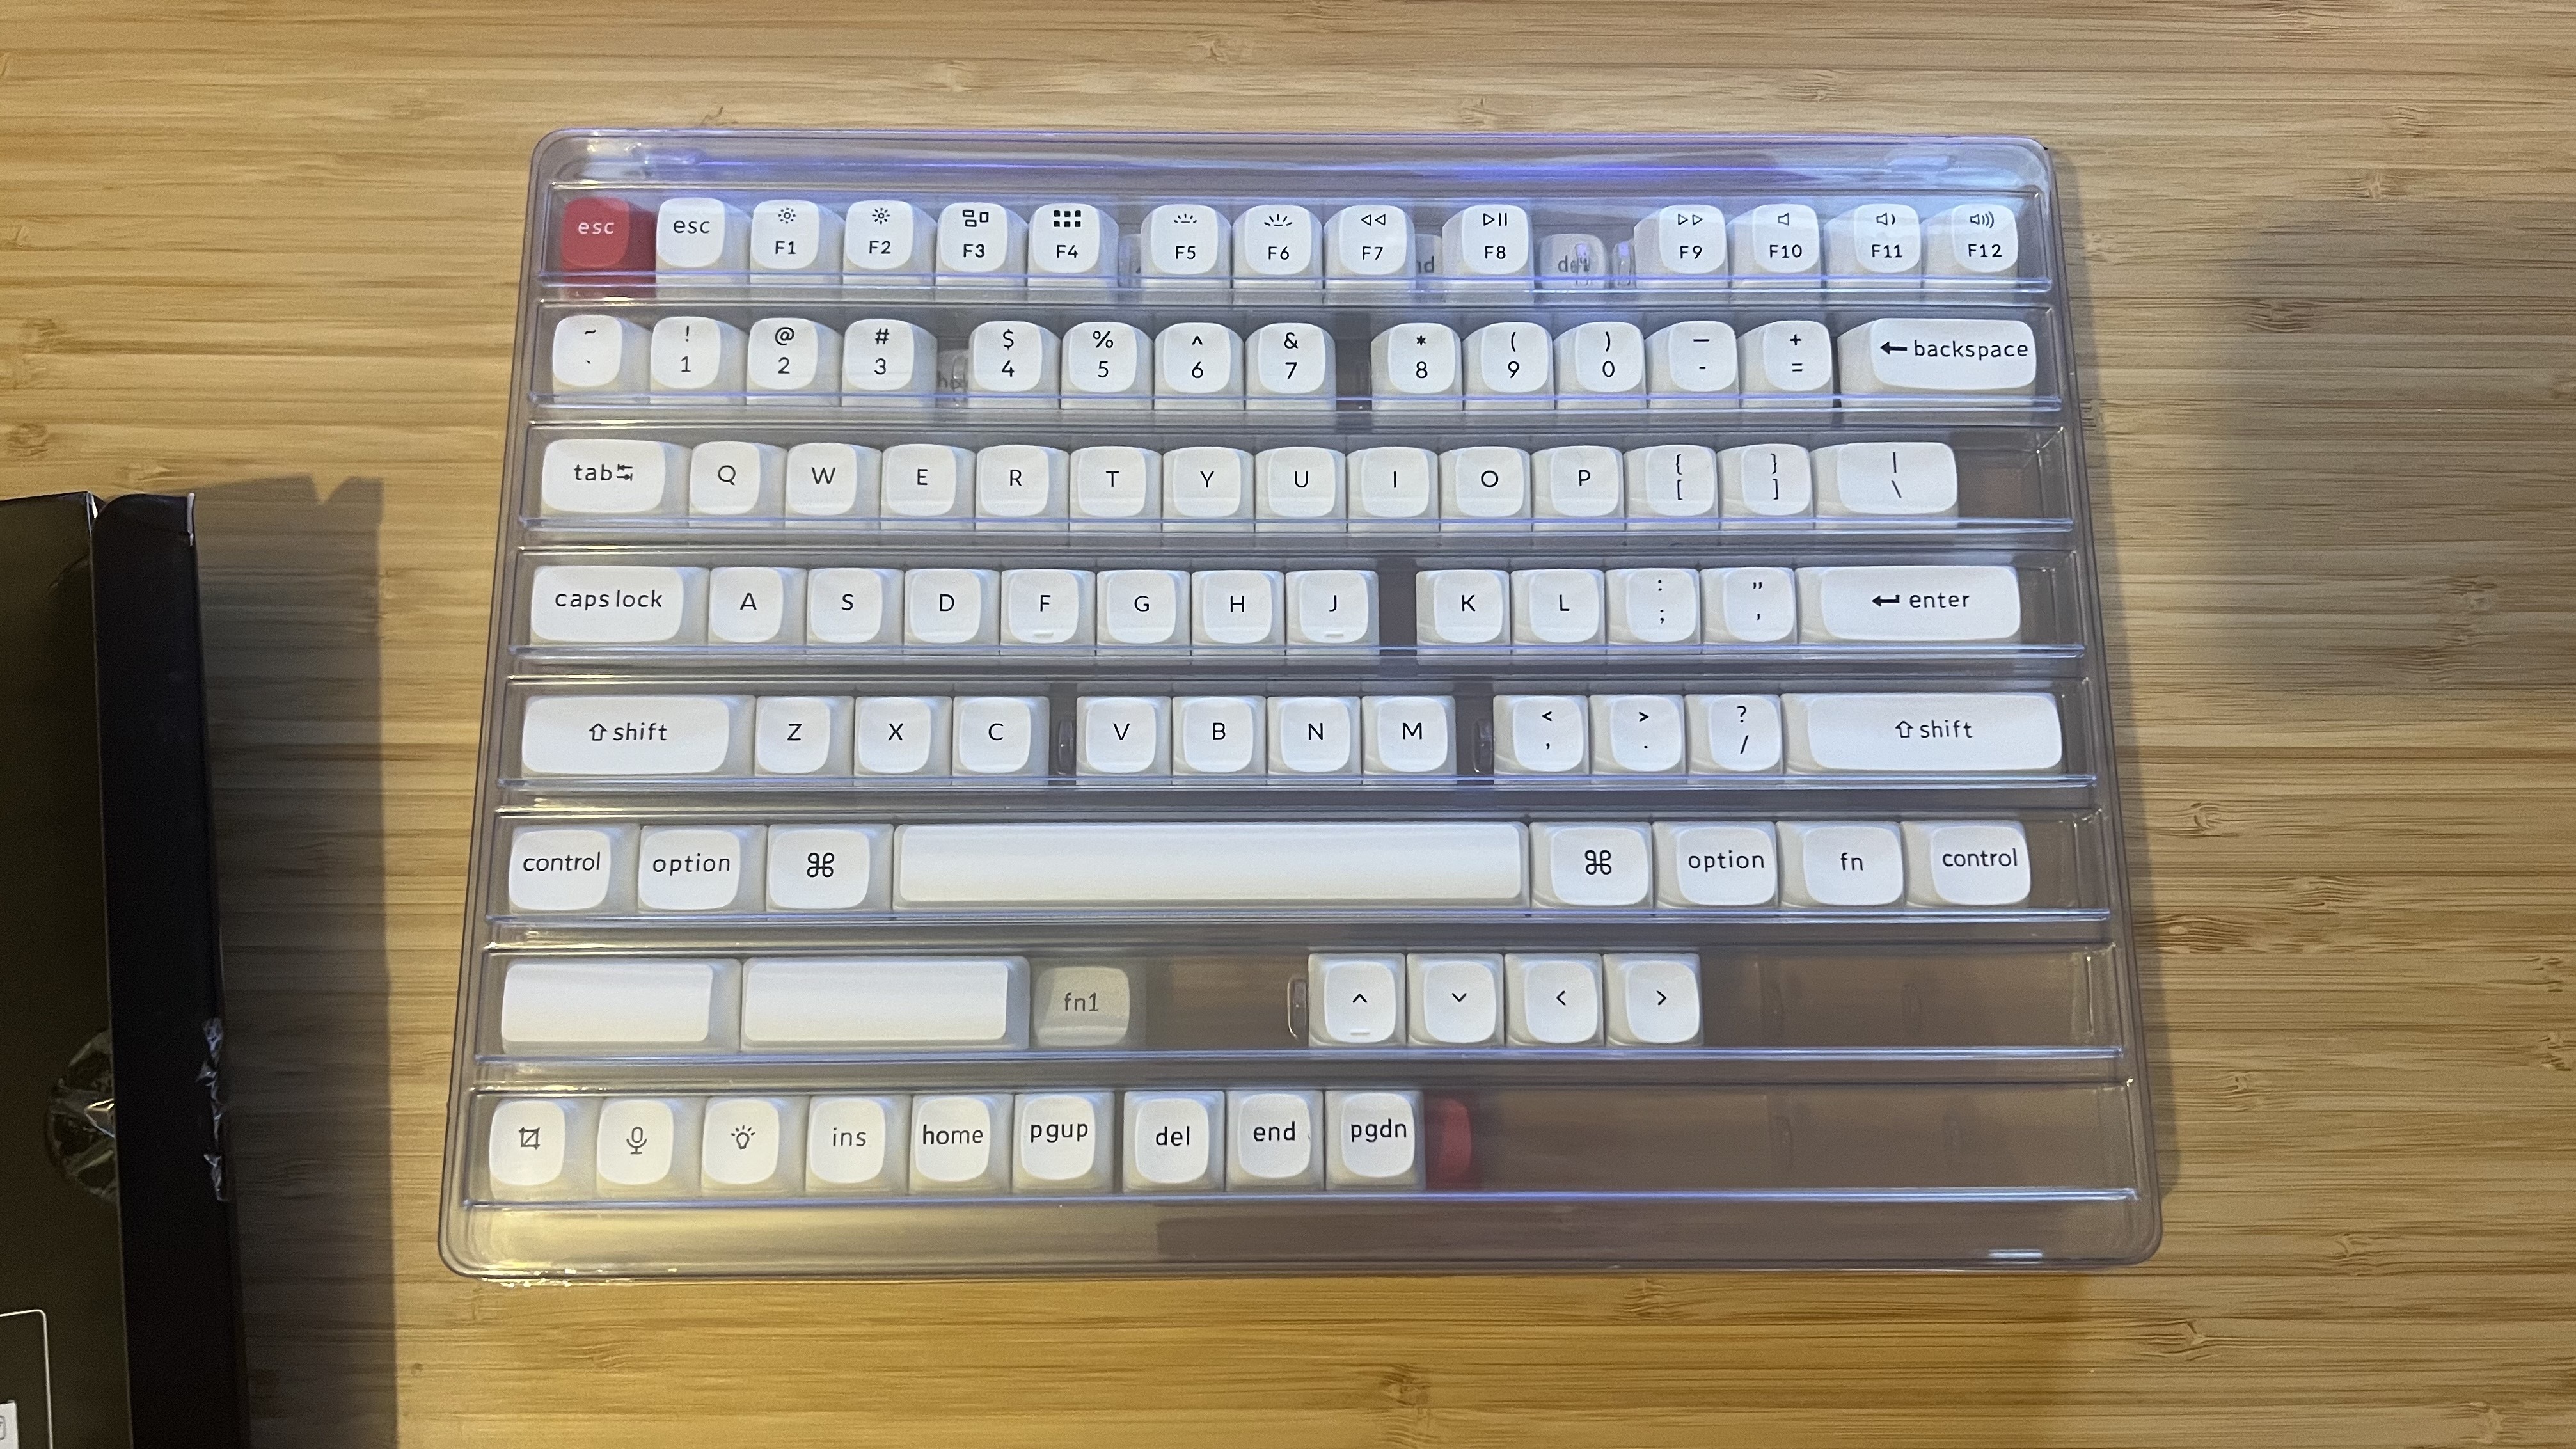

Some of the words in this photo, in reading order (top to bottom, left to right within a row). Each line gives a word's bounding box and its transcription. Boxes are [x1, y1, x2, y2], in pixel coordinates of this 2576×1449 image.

[578, 222, 615, 235] esc
[673, 220, 710, 234] esc
[775, 240, 796, 255] F1
[869, 240, 891, 255] F2
[963, 243, 985, 258] F3
[1056, 244, 1079, 258] F4
[1176, 245, 1196, 260] F5
[1268, 246, 1290, 260] F6
[1362, 246, 1384, 260] F7
[1485, 245, 1506, 260] F8
[1680, 245, 1702, 260] F9
[1769, 244, 1803, 258] F10
[1872, 244, 1902, 258] F11
[1968, 243, 2002, 258] F12
[774, 326, 795, 346] @
[874, 328, 890, 345] #
[1002, 328, 1015, 351] $
[1093, 330, 1114, 349] %
[1192, 335, 1203, 345] ^
[1284, 331, 1299, 349] &
[1510, 331, 1516, 352] (
[1605, 331, 1611, 352] )
[1789, 333, 1802, 346] +
[1914, 339, 2028, 361] backspace
[681, 355, 691, 372] 1
[777, 356, 790, 374] 2
[874, 358, 887, 376] 3
[1001, 360, 1015, 377] 4
[1098, 361, 1109, 378] 5
[1191, 361, 1204, 379] 6
[1285, 361, 1298, 379] 7
[1416, 361, 1428, 379] 8
[1507, 360, 1520, 379] 9
[1602, 360, 1615, 378] 0
[1791, 363, 1803, 372] =
[574, 463, 612, 481] tab
[1675, 453, 1682, 476] {
[1771, 453, 1777, 475] }
[717, 464, 736, 486] Q
[811, 467, 836, 485] W
[917, 468, 928, 486] E
[1009, 469, 1022, 487] R
[1105, 470, 1119, 487] T
[1199, 470, 1215, 488] Y
[1294, 471, 1309, 488] U
[1480, 470, 1499, 488] O
[1578, 470, 1591, 487] P
[1677, 479, 1683, 501] [
[1772, 478, 1779, 500] ]
[1891, 480, 1902, 498] \
[555, 593, 610, 611] caps
[616, 589, 663, 608] lock
[739, 592, 757, 610] A
[841, 593, 854, 611] S
[939, 594, 955, 612] D
[1039, 594, 1051, 612] F
[1134, 595, 1150, 612] G
[1230, 595, 1245, 613] H
[1329, 594, 1337, 612] J
[1461, 594, 1476, 612] K
[1559, 594, 1570, 612] L
[1909, 592, 1970, 608] enter
[1542, 711, 1553, 722] <
[1638, 711, 1649, 722] >
[1736, 705, 1747, 723] ?
[613, 722, 667, 741] shift
[787, 723, 802, 741] Z
[888, 723, 904, 741] X
[988, 723, 1004, 741] C
[1113, 723, 1130, 741] V
[1213, 722, 1226, 740] B
[1308, 722, 1324, 741] N
[1402, 722, 1423, 740] M
[1920, 719, 1973, 738] shift
[1740, 734, 1749, 754] /
[523, 851, 601, 872] control
[652, 853, 730, 876] option
[1688, 850, 1764, 873] option
[1840, 852, 1863, 871] fn
[1942, 848, 2018, 867] control
[1064, 992, 1099, 1012] fn1
[833, 1127, 867, 1147] ins
[922, 1123, 983, 1145] home
[1031, 1123, 1088, 1143] pgup
[1155, 1125, 1190, 1146] del
[1253, 1121, 1295, 1142] end
[1350, 1118, 1407, 1143] pgdn
